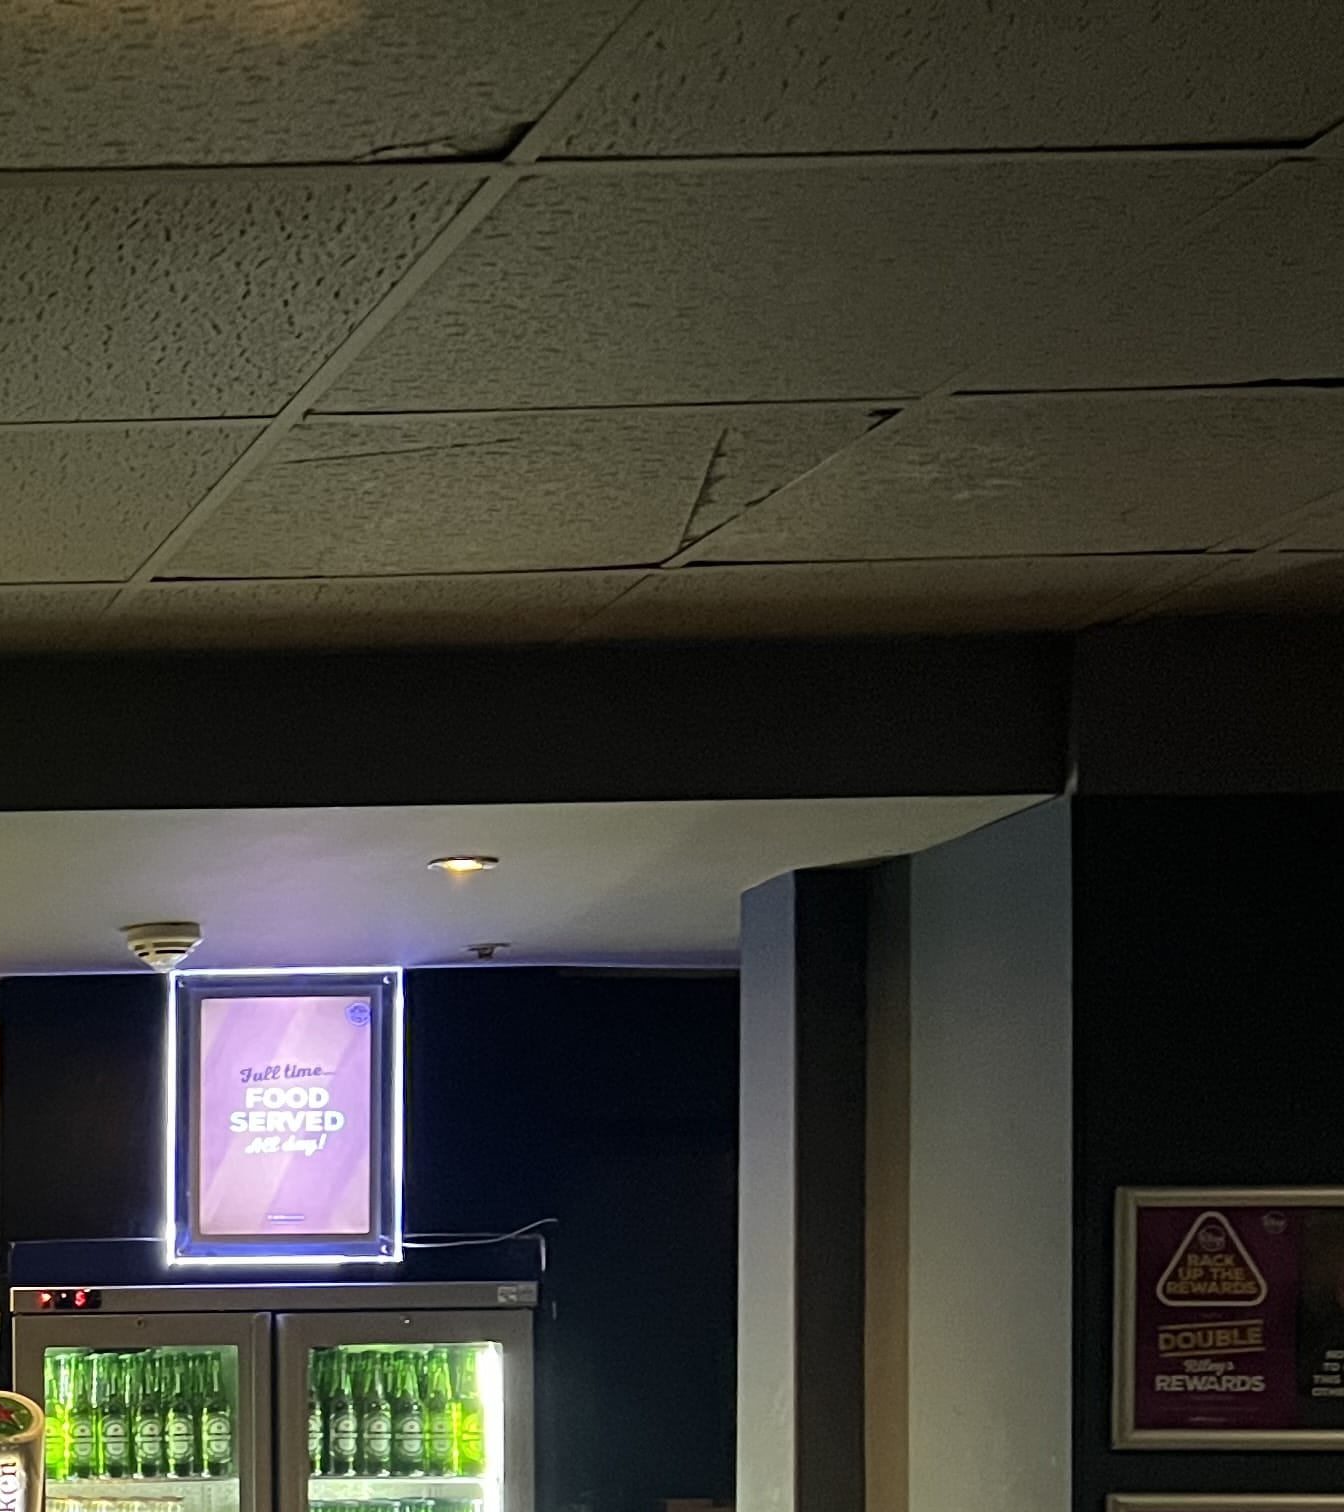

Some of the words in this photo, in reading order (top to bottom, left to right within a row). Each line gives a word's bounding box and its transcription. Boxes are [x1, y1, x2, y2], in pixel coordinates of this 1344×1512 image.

[240, 1065, 280, 1083] Full
[245, 1086, 329, 1109] FOOD
[229, 1110, 345, 1132] SERVED
[1177, 1267, 1204, 1280] UP
[1209, 1267, 1246, 1280] THE
[1165, 1281, 1258, 1294] REWARDS
[1158, 1327, 1262, 1349] DOUBLE
[1155, 1375, 1265, 1391] REWARDS
